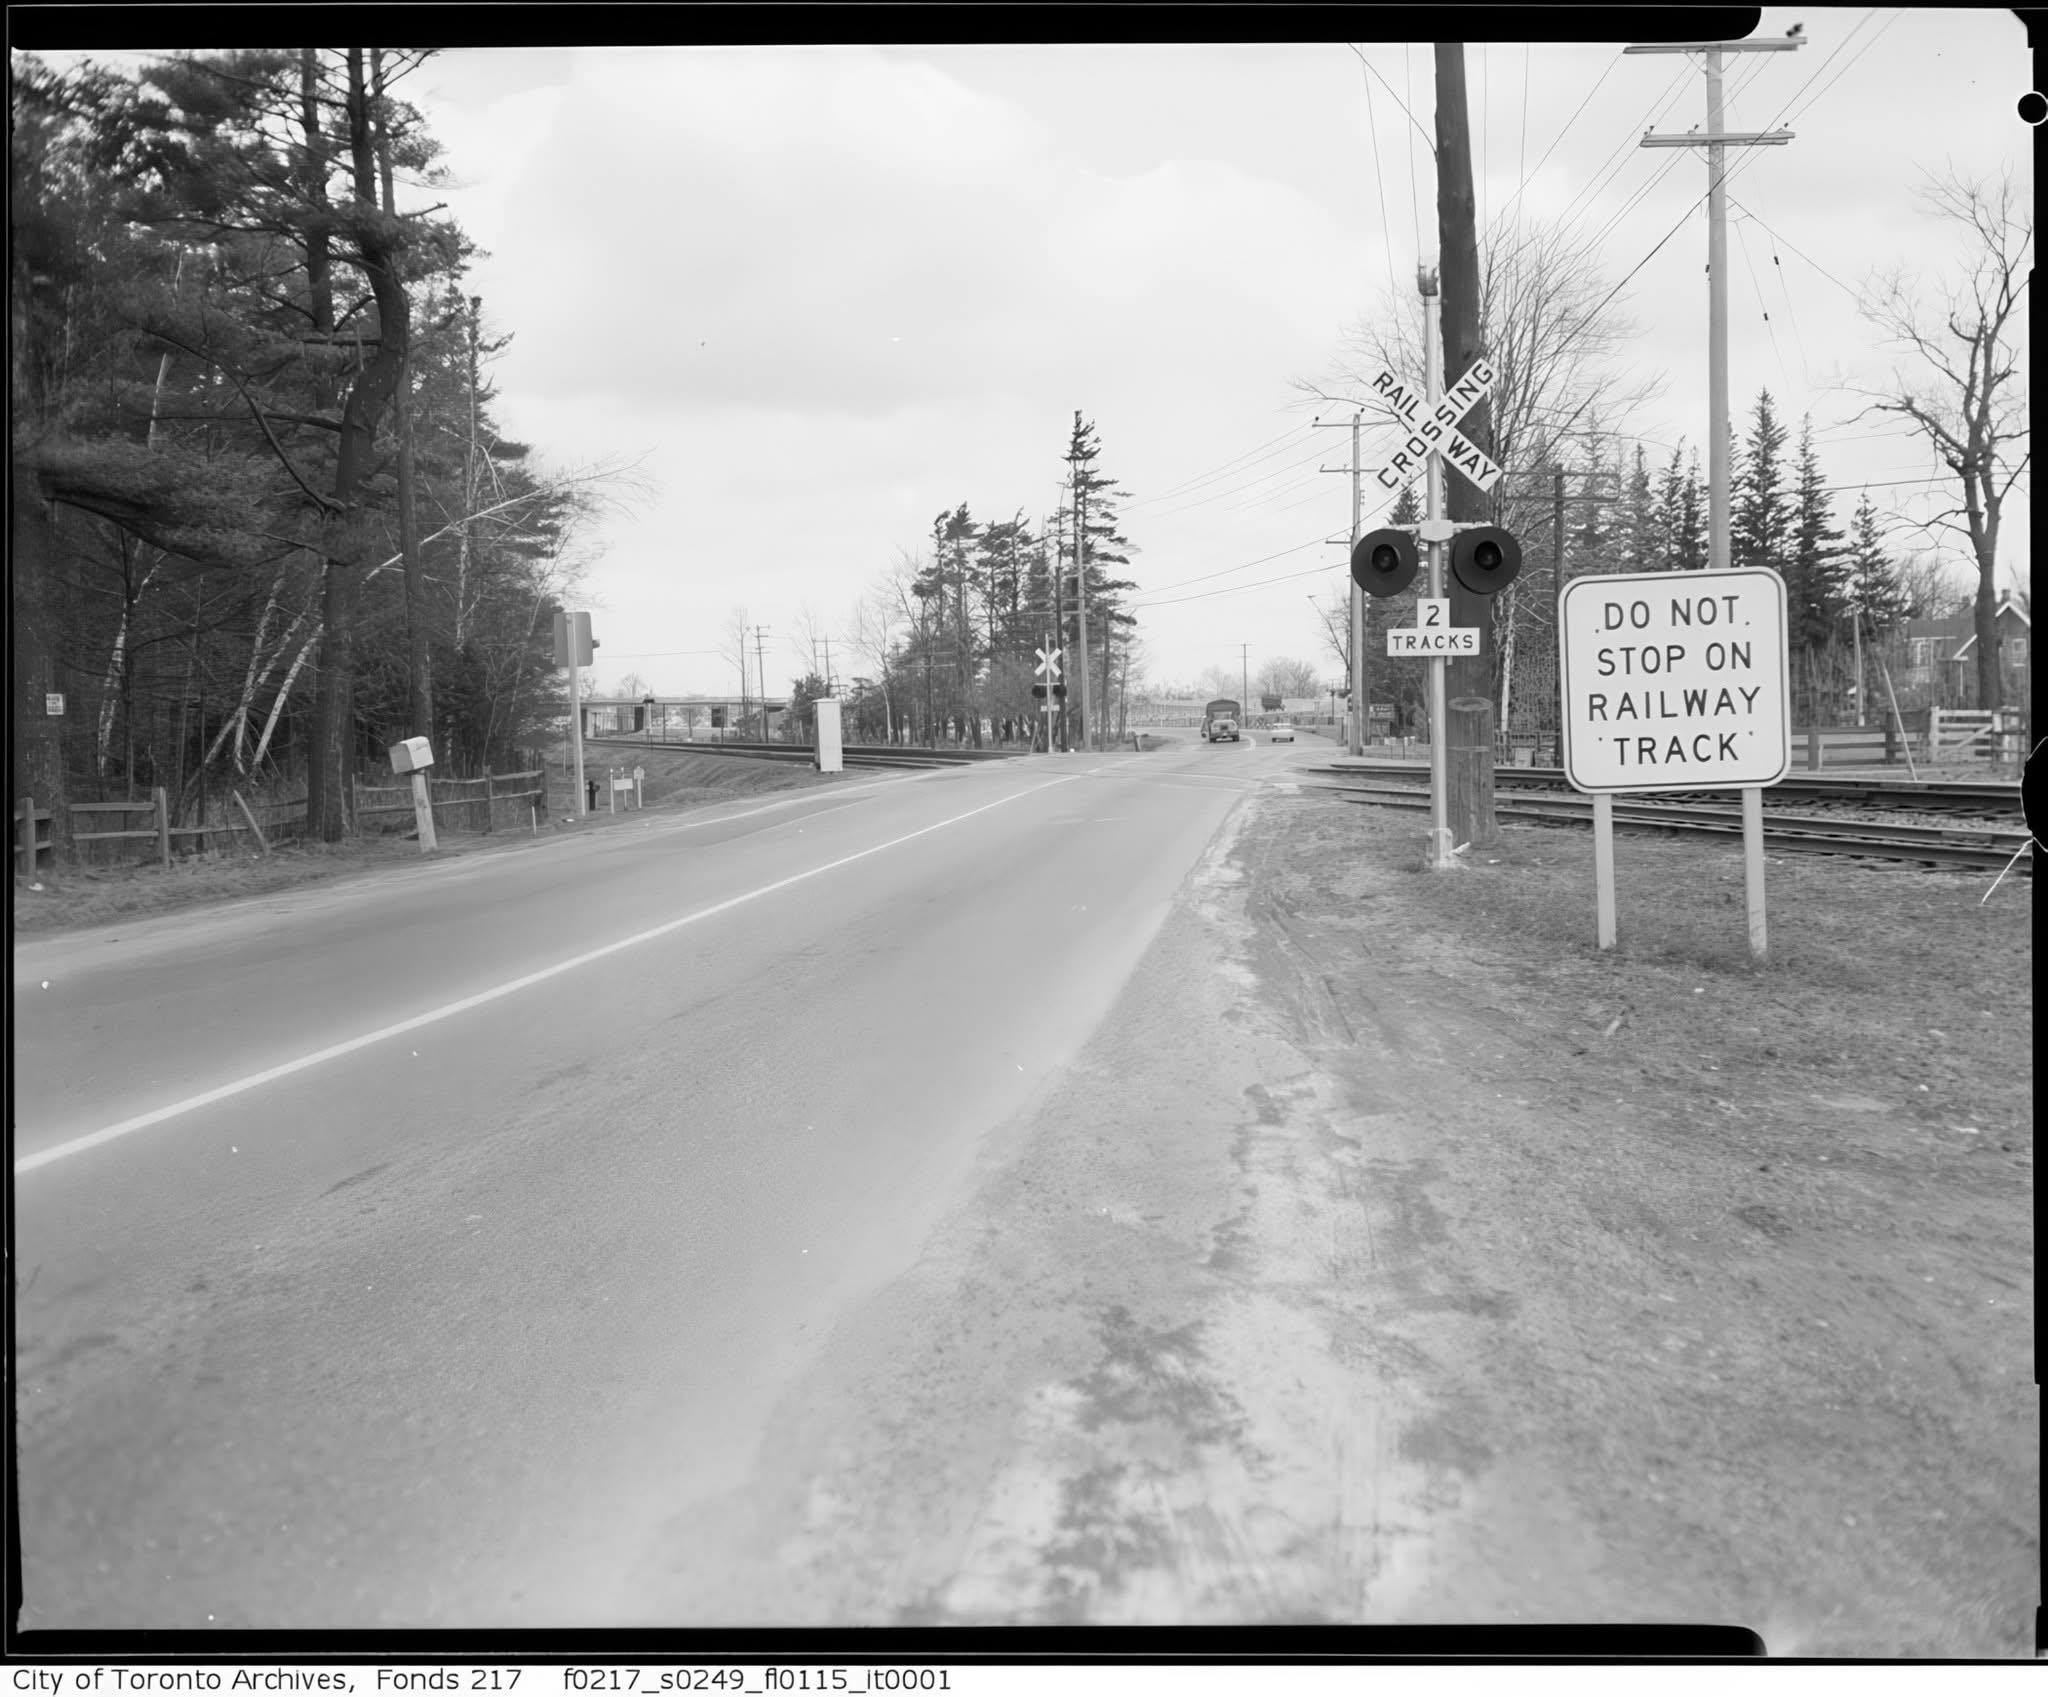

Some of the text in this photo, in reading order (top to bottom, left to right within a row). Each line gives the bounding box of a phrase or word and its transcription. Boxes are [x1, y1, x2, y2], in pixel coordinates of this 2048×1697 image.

[1372, 370, 1498, 486] RAIL WAY
[1377, 362, 1494, 489] CROSSING
[1426, 604, 1440, 627] 2
[1604, 595, 1740, 631] DO NOT
[1392, 634, 1473, 650] TRACKS
[1597, 641, 1751, 677] STOP ON
[1588, 686, 1761, 722] RAILWAY
[1613, 732, 1739, 766] TRACK
